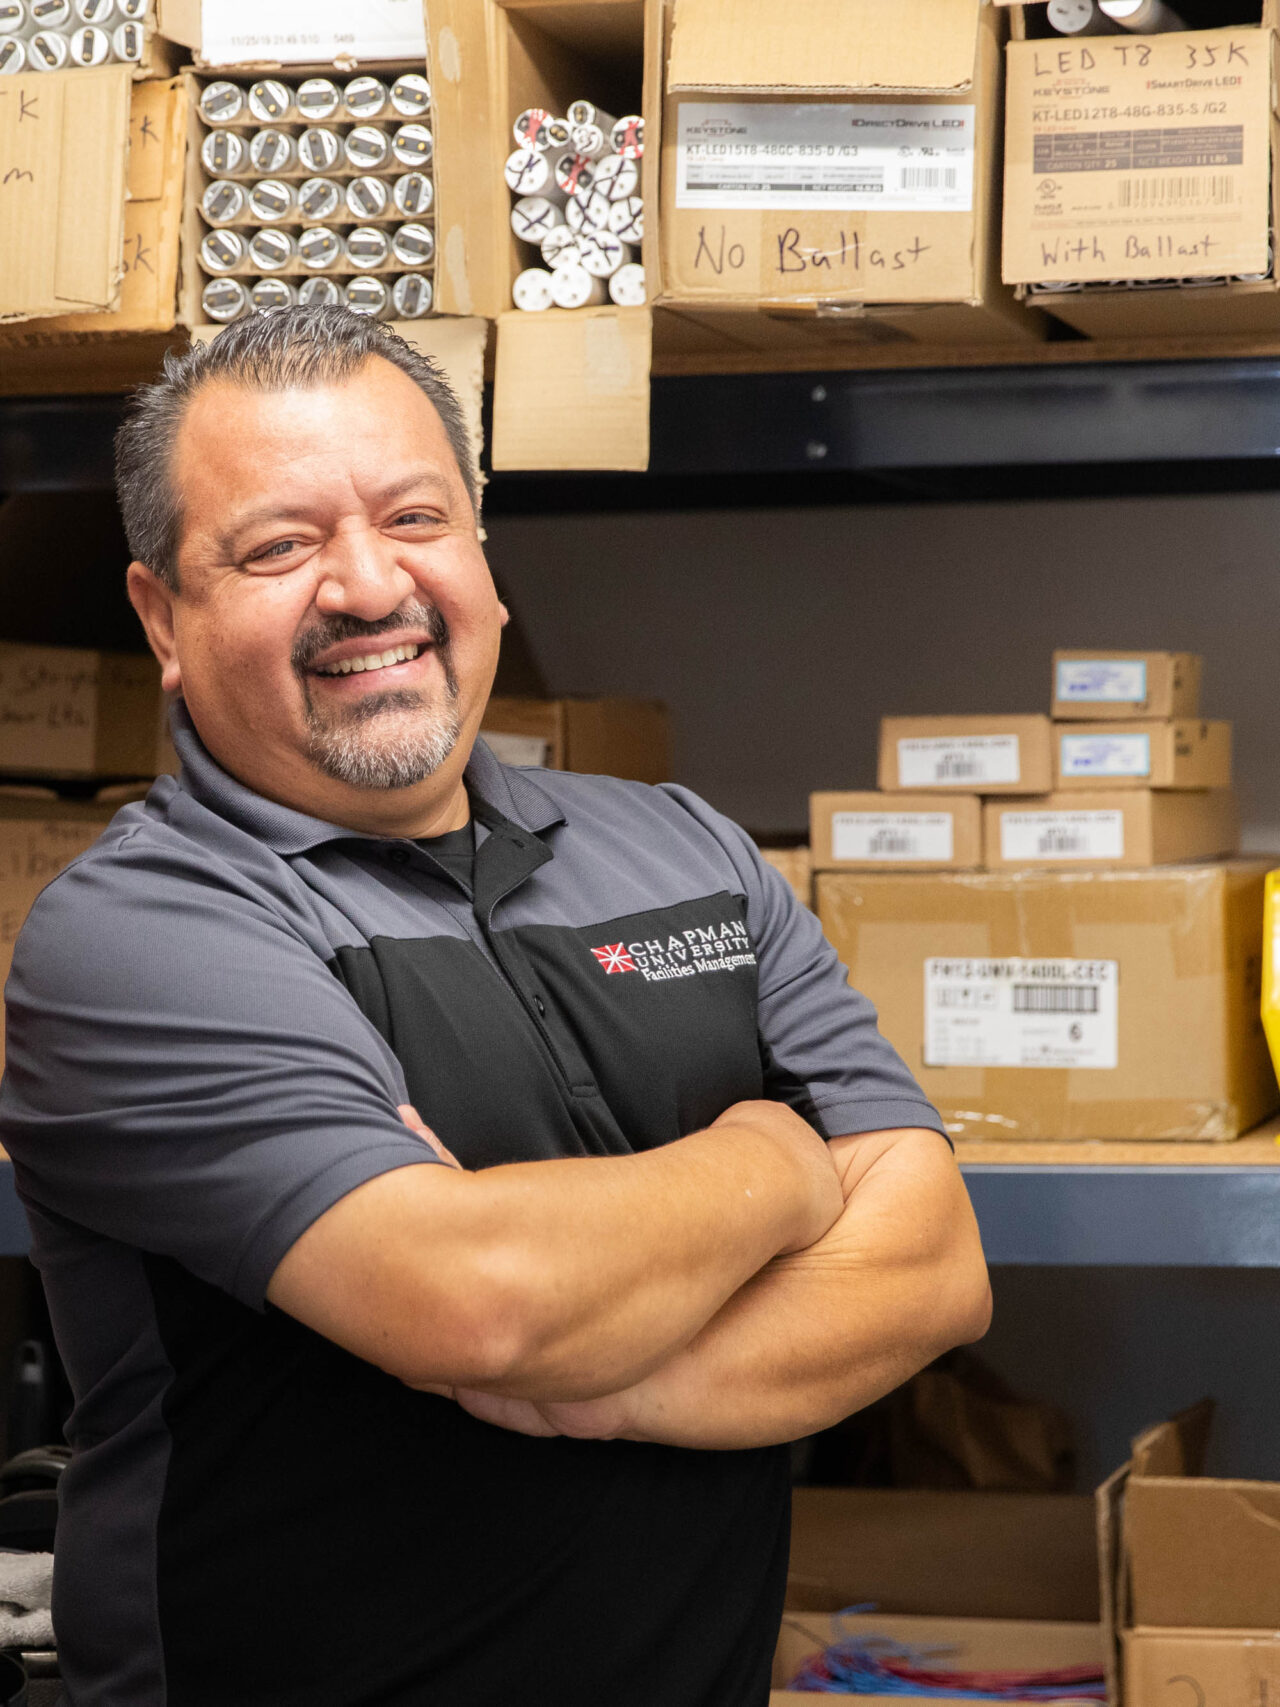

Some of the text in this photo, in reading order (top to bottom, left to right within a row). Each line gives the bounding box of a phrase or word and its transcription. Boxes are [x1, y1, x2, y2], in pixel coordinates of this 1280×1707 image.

[1034, 42, 1249, 76] LED T8 35K
[1032, 85, 1111, 97] KEYSTONE
[1214, 76, 1237, 87] LED
[685, 126, 747, 134] KEYSTONE
[931, 119, 961, 128] LED
[693, 225, 932, 275] No Ballast
[1041, 234, 1221, 267] With Ballast
[627, 919, 748, 957] CHAPMAN
[634, 936, 750, 968] UNIVERSITY
[640, 952, 757, 982] Facilities Management
